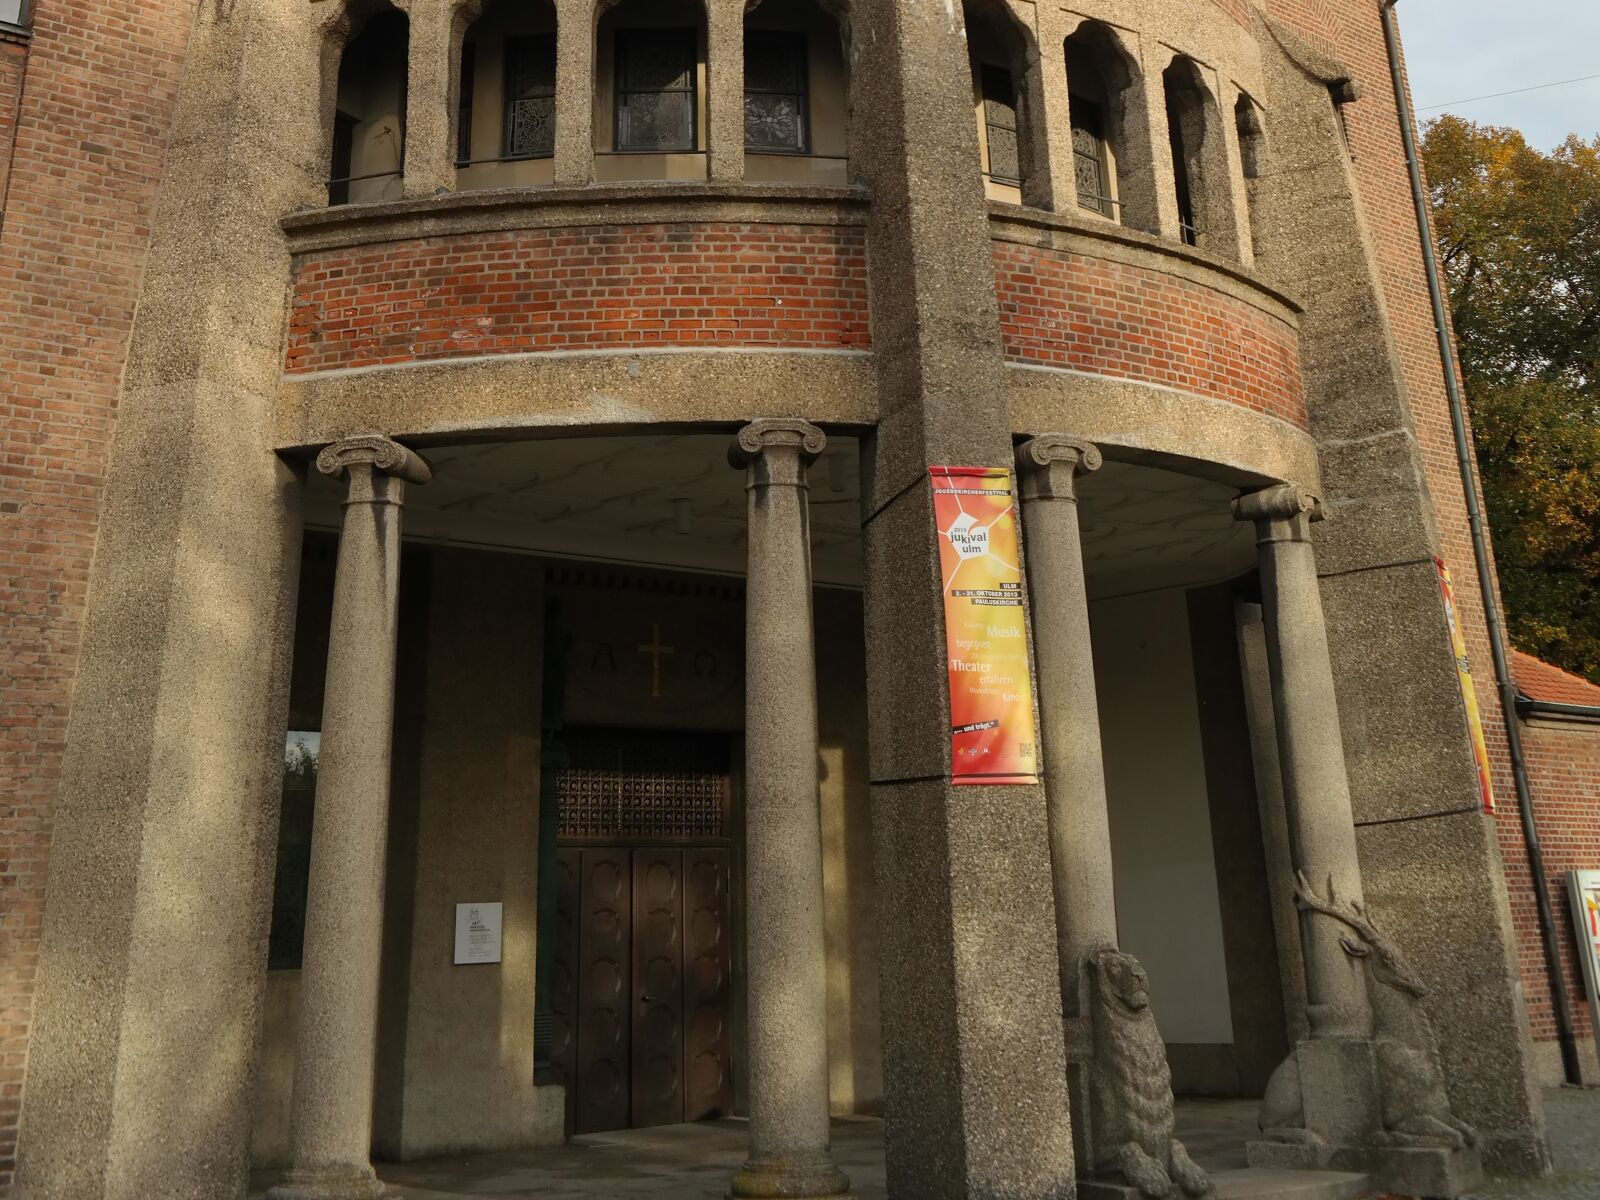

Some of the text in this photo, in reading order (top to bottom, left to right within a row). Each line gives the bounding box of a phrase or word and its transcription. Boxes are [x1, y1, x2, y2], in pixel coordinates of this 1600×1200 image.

[951, 532, 986, 544] jukival
[962, 545, 981, 553] ulm
[987, 625, 1021, 638] Musik
[956, 639, 991, 649] begegnen
[951, 659, 992, 672] Theater
[980, 675, 1013, 685] erfahren
[1002, 692, 1021, 701] Kino
